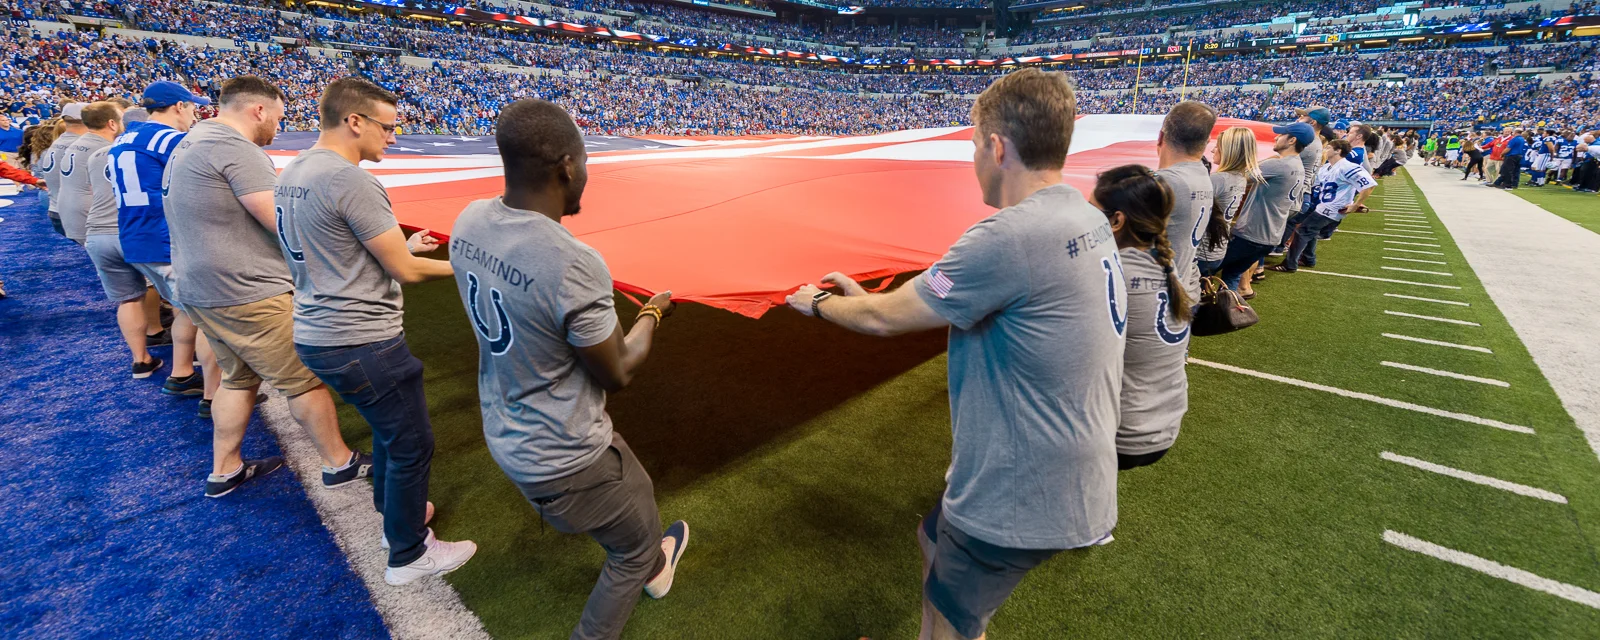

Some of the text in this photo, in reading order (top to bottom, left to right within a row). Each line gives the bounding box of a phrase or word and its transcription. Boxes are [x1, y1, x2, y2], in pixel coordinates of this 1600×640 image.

[1319, 181, 1339, 204] 8
[1356, 176, 1370, 188] 18
[451, 237, 535, 293] #TEAMINDY
